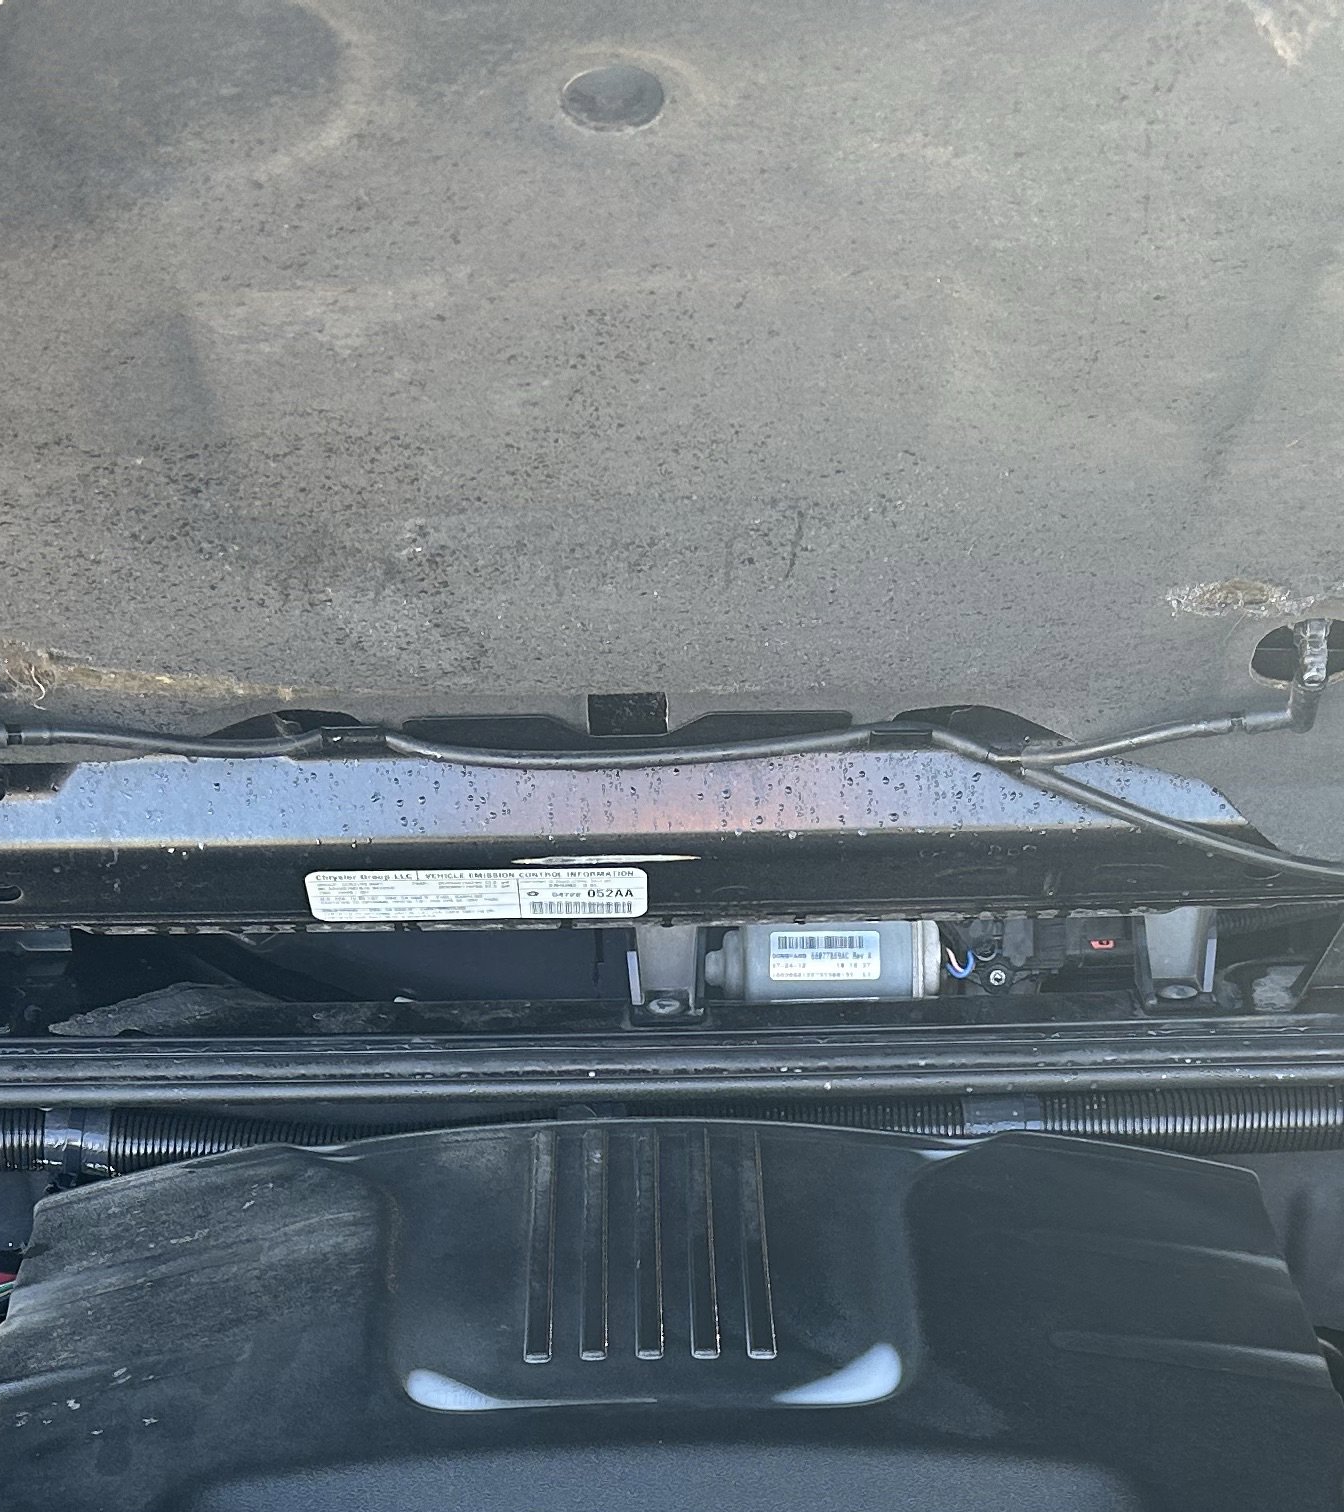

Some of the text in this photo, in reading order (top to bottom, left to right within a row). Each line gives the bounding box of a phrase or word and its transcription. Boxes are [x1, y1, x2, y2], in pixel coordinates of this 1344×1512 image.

[425, 872, 464, 880] VEHICLE
[469, 871, 515, 879] EMISSION
[567, 870, 634, 878] INFORMATION
[587, 888, 634, 898] 052AA
